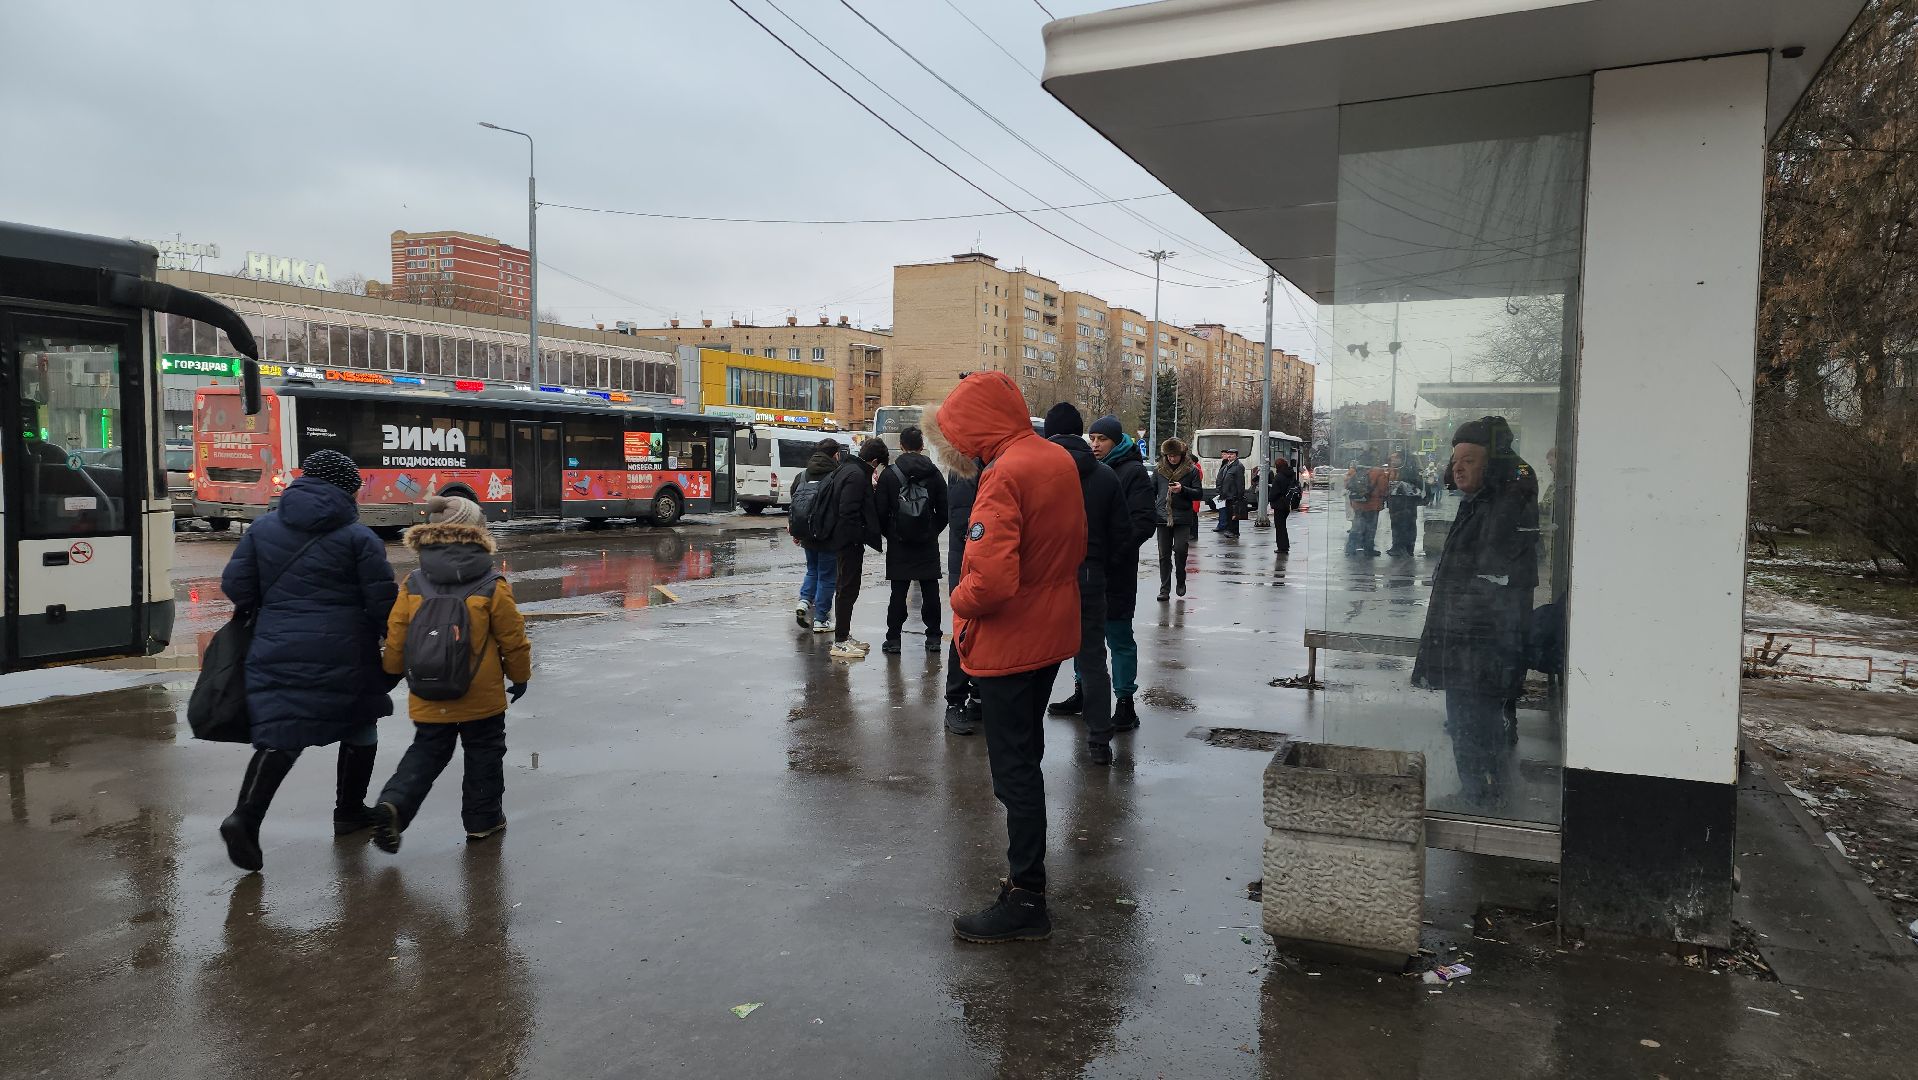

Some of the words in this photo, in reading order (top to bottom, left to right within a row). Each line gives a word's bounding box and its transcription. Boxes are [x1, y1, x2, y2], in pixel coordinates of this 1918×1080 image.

[247, 251, 330, 289] НИКА
[174, 359, 229, 372] ГОРЗДРАВ
[213, 434, 252, 449] ЗИМА
[381, 424, 467, 453] ЗИМА
[382, 455, 391, 466] В
[391, 456, 467, 468] ПОДМОСКОВЬЕ
